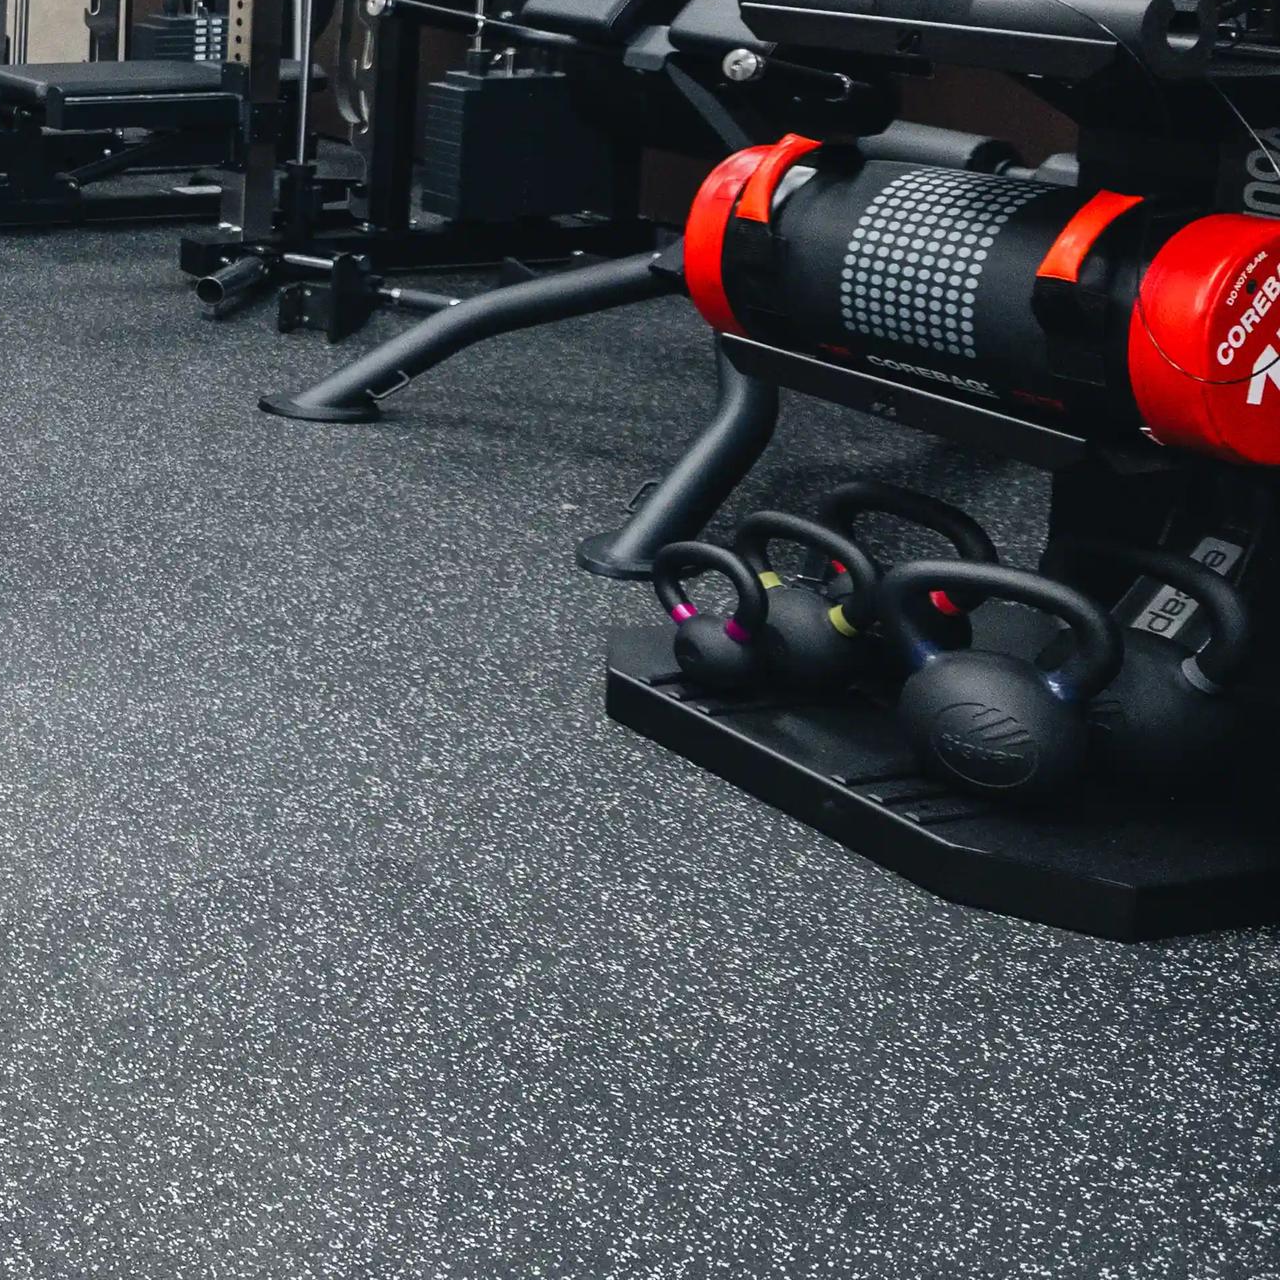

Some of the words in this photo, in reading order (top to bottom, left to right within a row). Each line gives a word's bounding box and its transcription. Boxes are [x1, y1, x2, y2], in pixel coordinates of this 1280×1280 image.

[1216, 263, 1280, 366] COREB
[1226, 289, 1239, 306] DO
[1233, 270, 1249, 292] NOT
